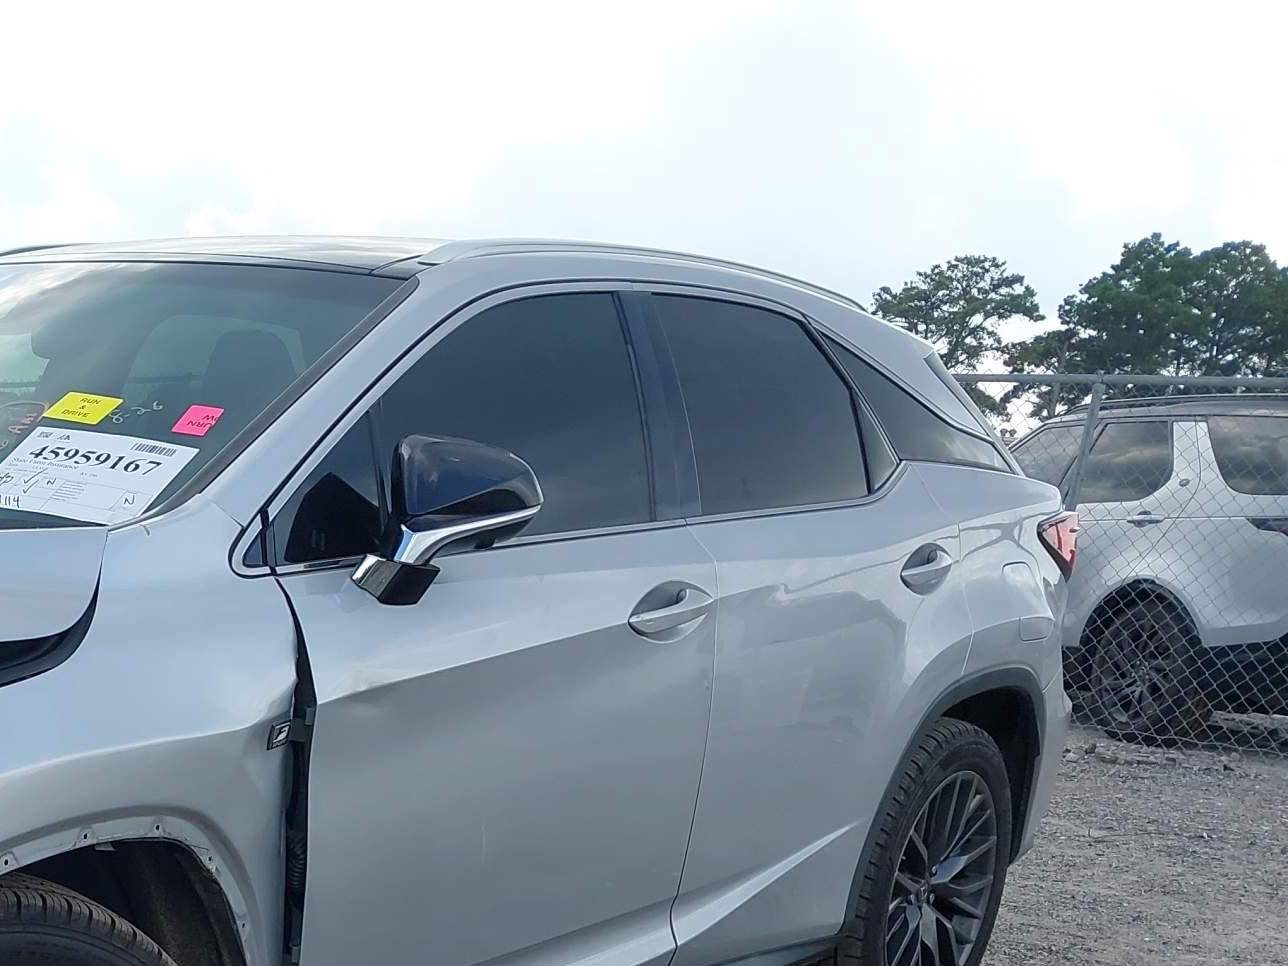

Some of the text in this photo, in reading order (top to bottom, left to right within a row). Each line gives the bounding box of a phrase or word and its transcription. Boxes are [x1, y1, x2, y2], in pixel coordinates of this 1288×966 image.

[79, 397, 101, 406] RUN
[61, 408, 90, 419] DRIVE
[29, 444, 163, 476] 45959167
